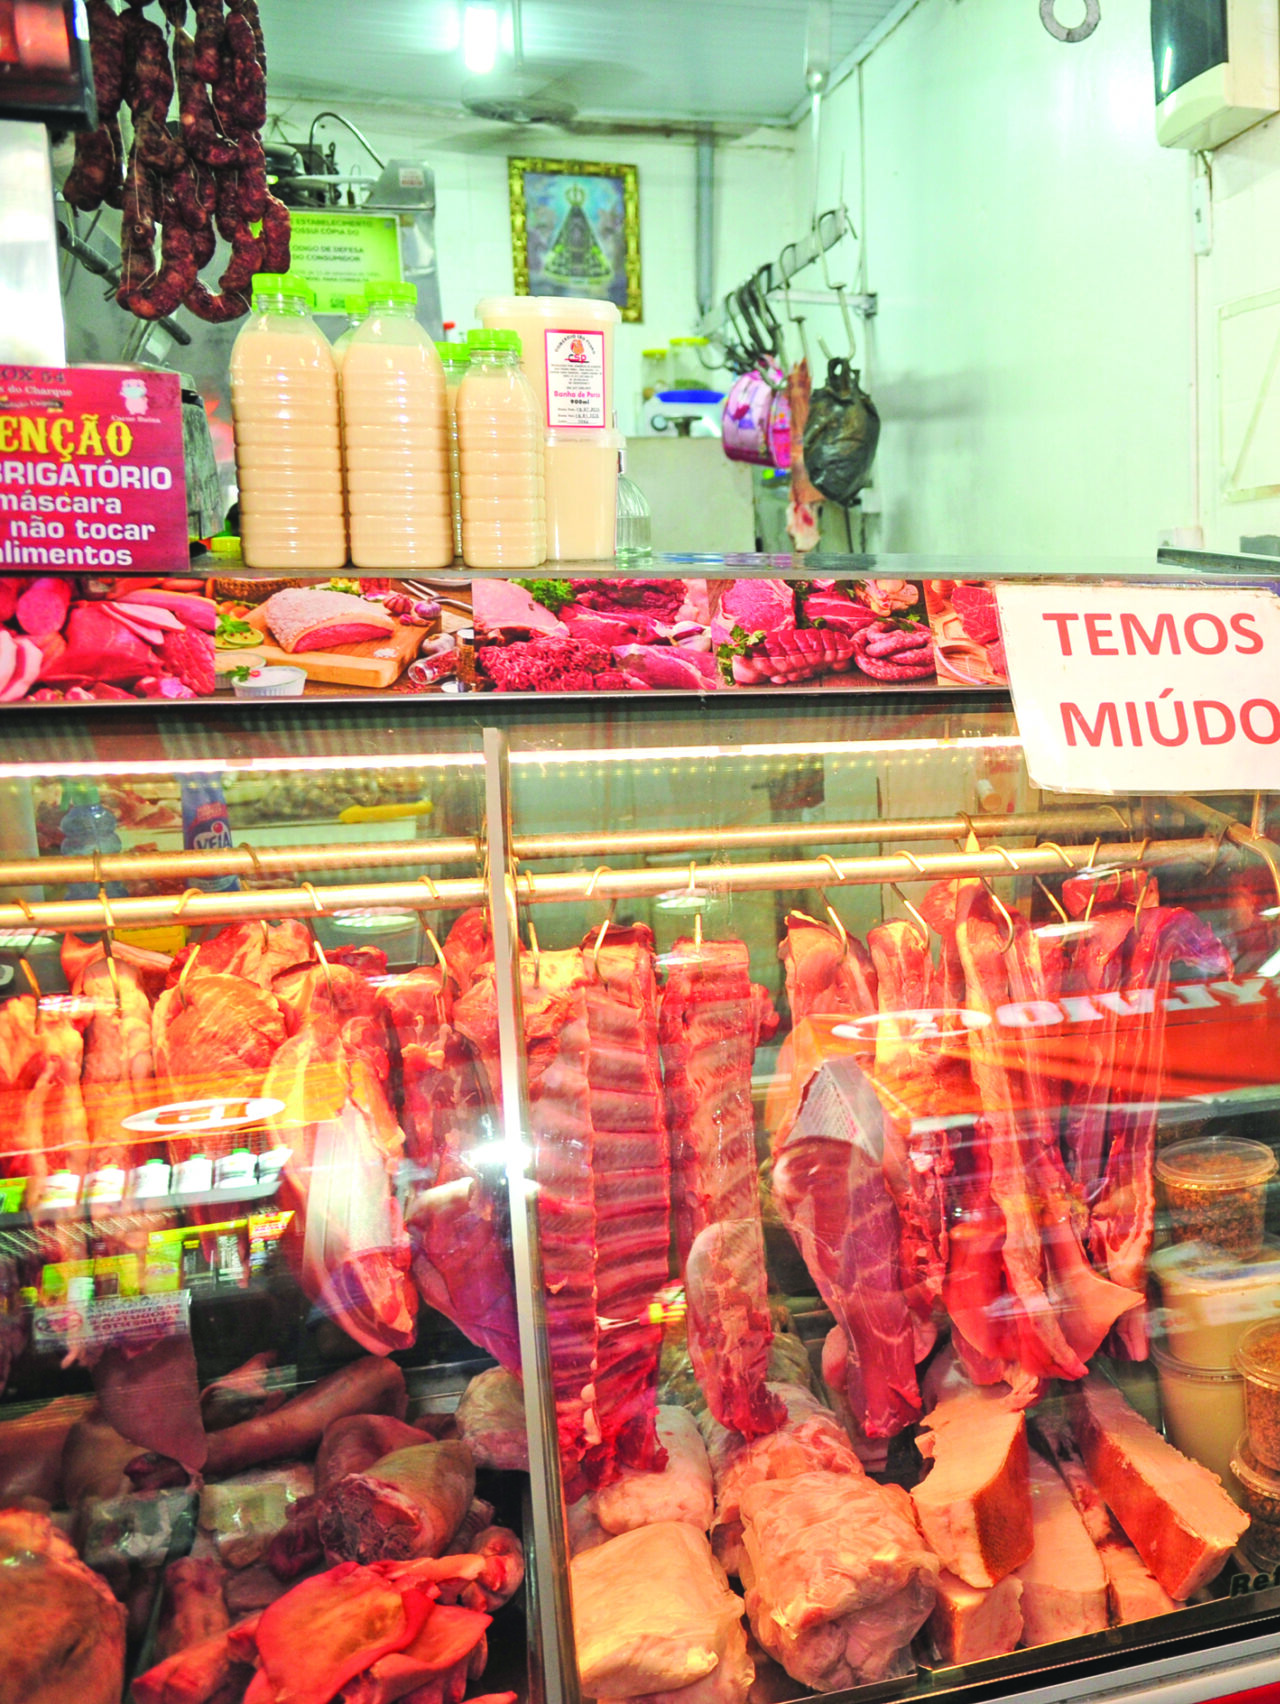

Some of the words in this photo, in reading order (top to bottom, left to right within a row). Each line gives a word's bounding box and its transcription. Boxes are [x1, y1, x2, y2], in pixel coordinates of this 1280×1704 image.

[0, 367, 34, 381] OX
[0, 459, 173, 490] RIGATÓRIO
[10, 514, 65, 539] não
[75, 519, 156, 541] tocar
[0, 540, 133, 566] limentos
[1042, 612, 1264, 656] TEMOS
